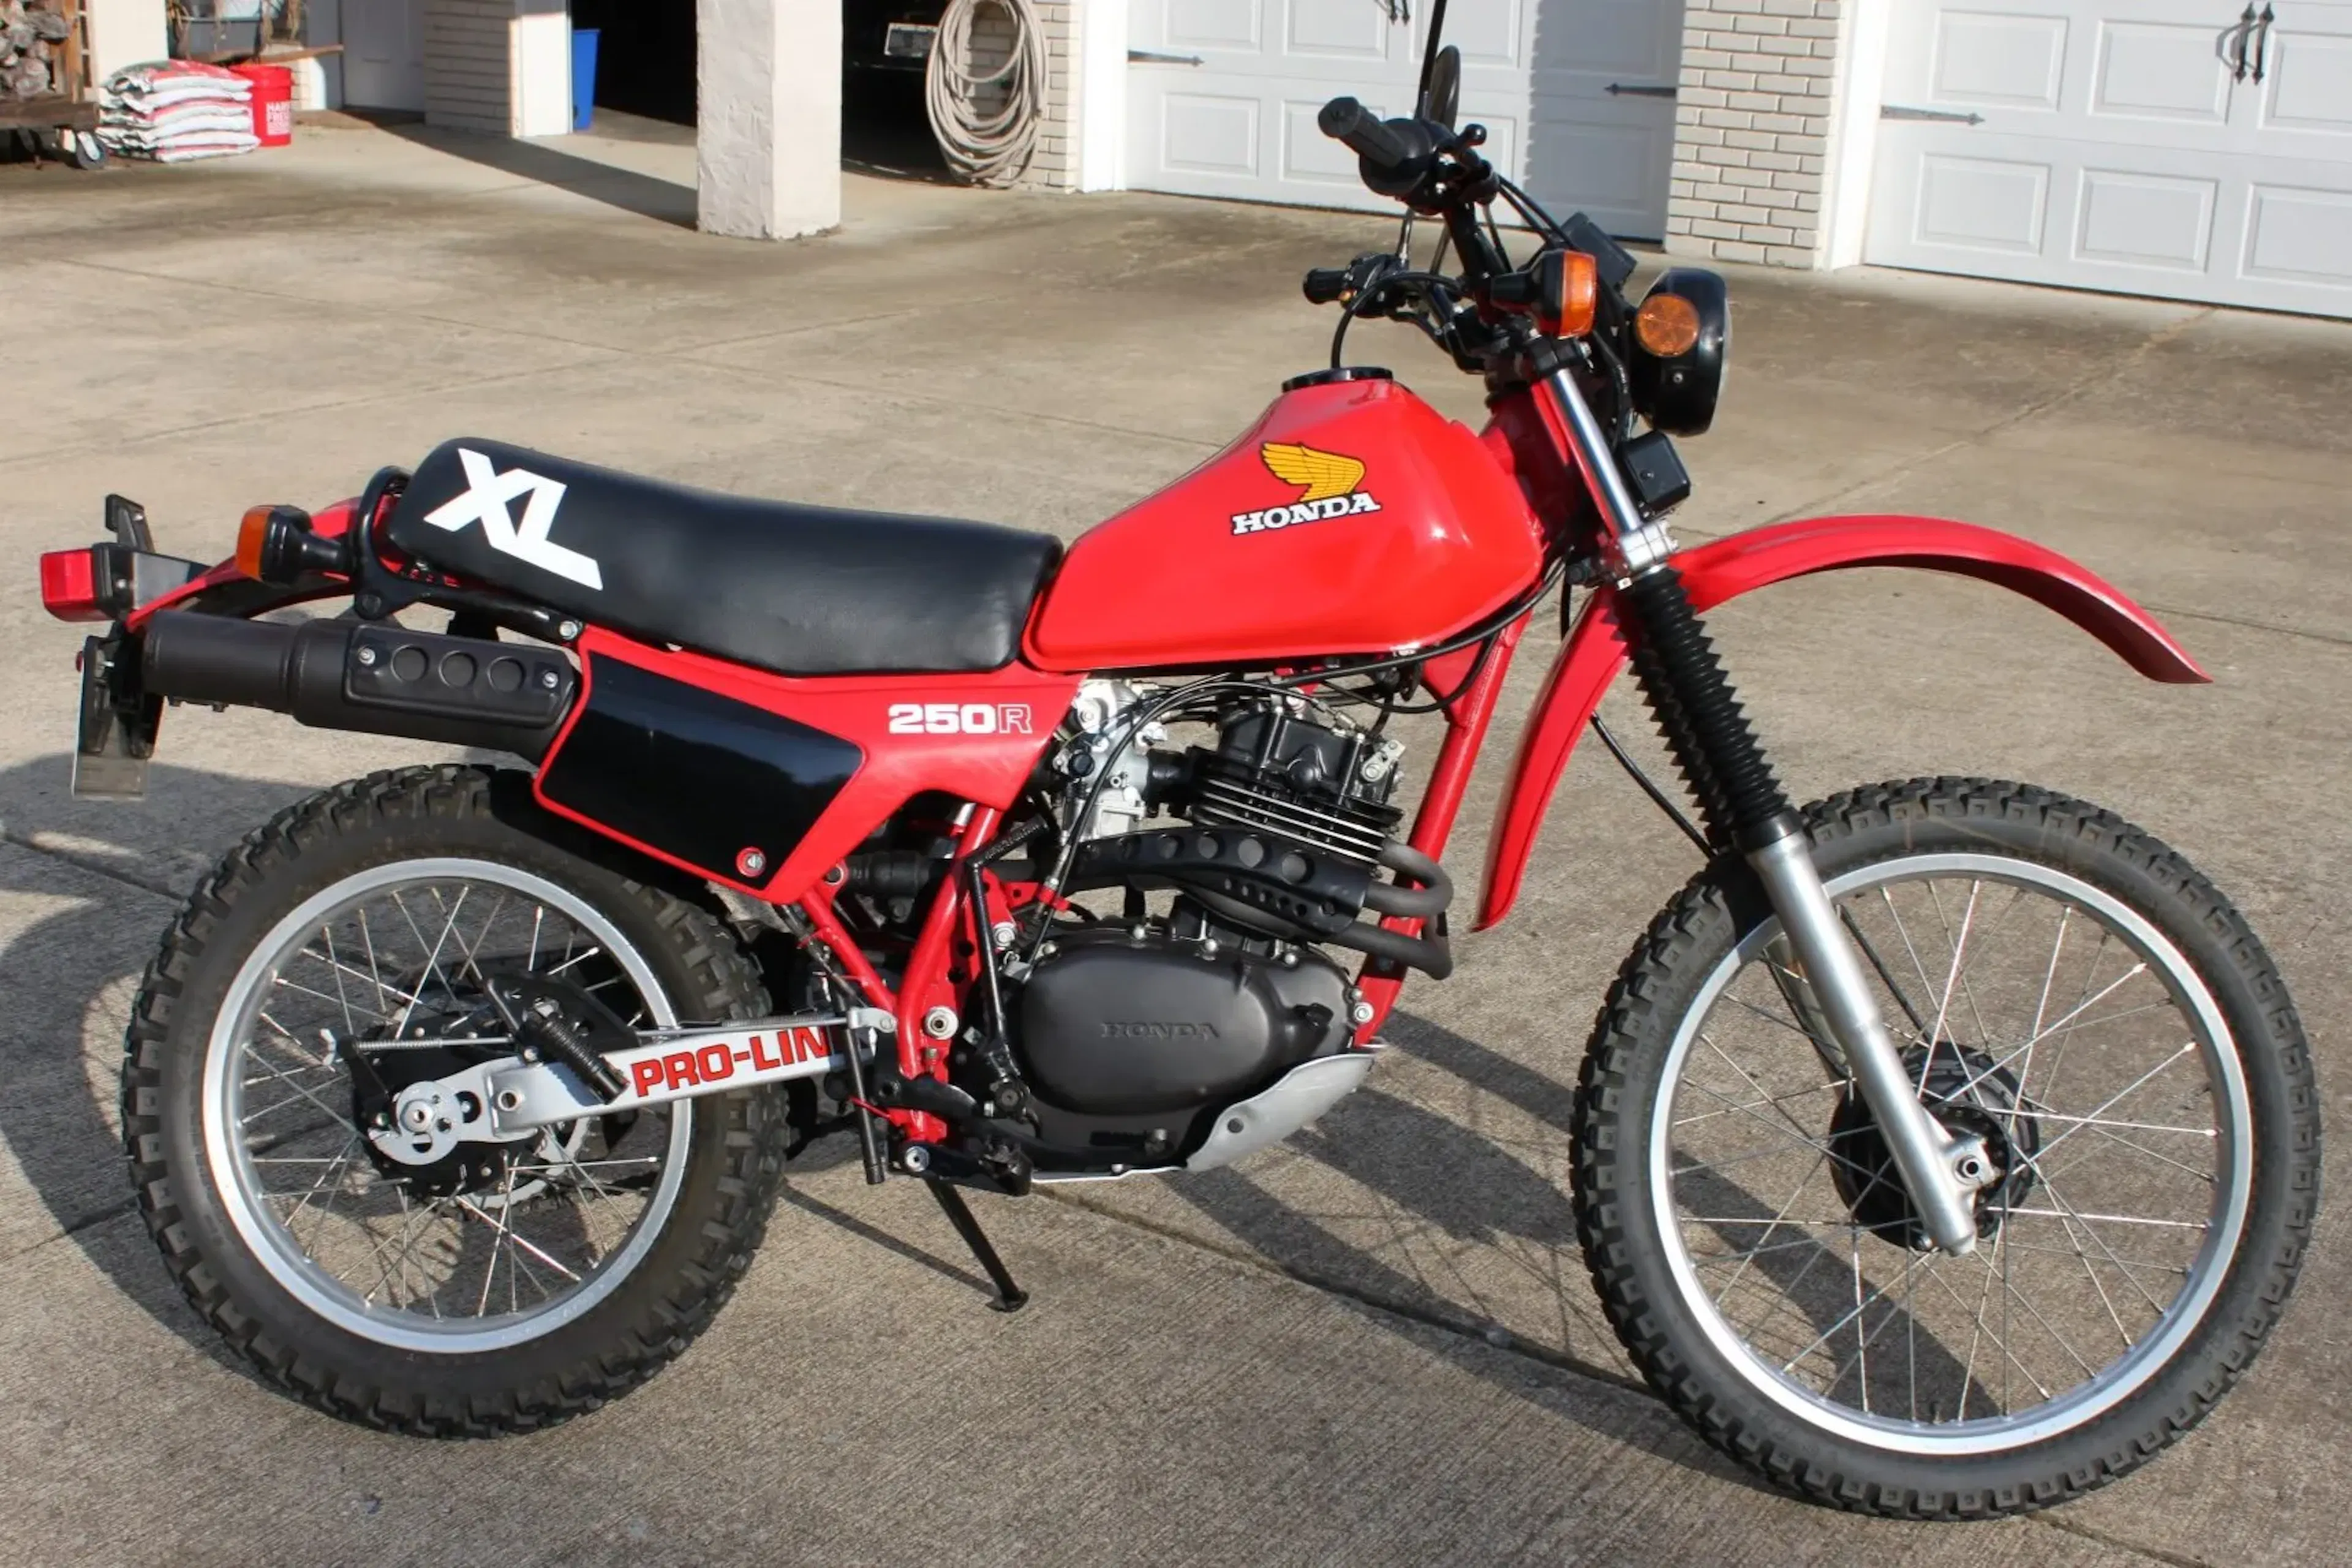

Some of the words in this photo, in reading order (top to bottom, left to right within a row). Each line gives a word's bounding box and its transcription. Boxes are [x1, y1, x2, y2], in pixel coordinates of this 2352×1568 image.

[423, 448, 603, 590] XL
[1232, 492, 1382, 535] HONDA
[888, 704, 1033, 734] 250R
[1101, 1021, 1220, 1039] HONDA
